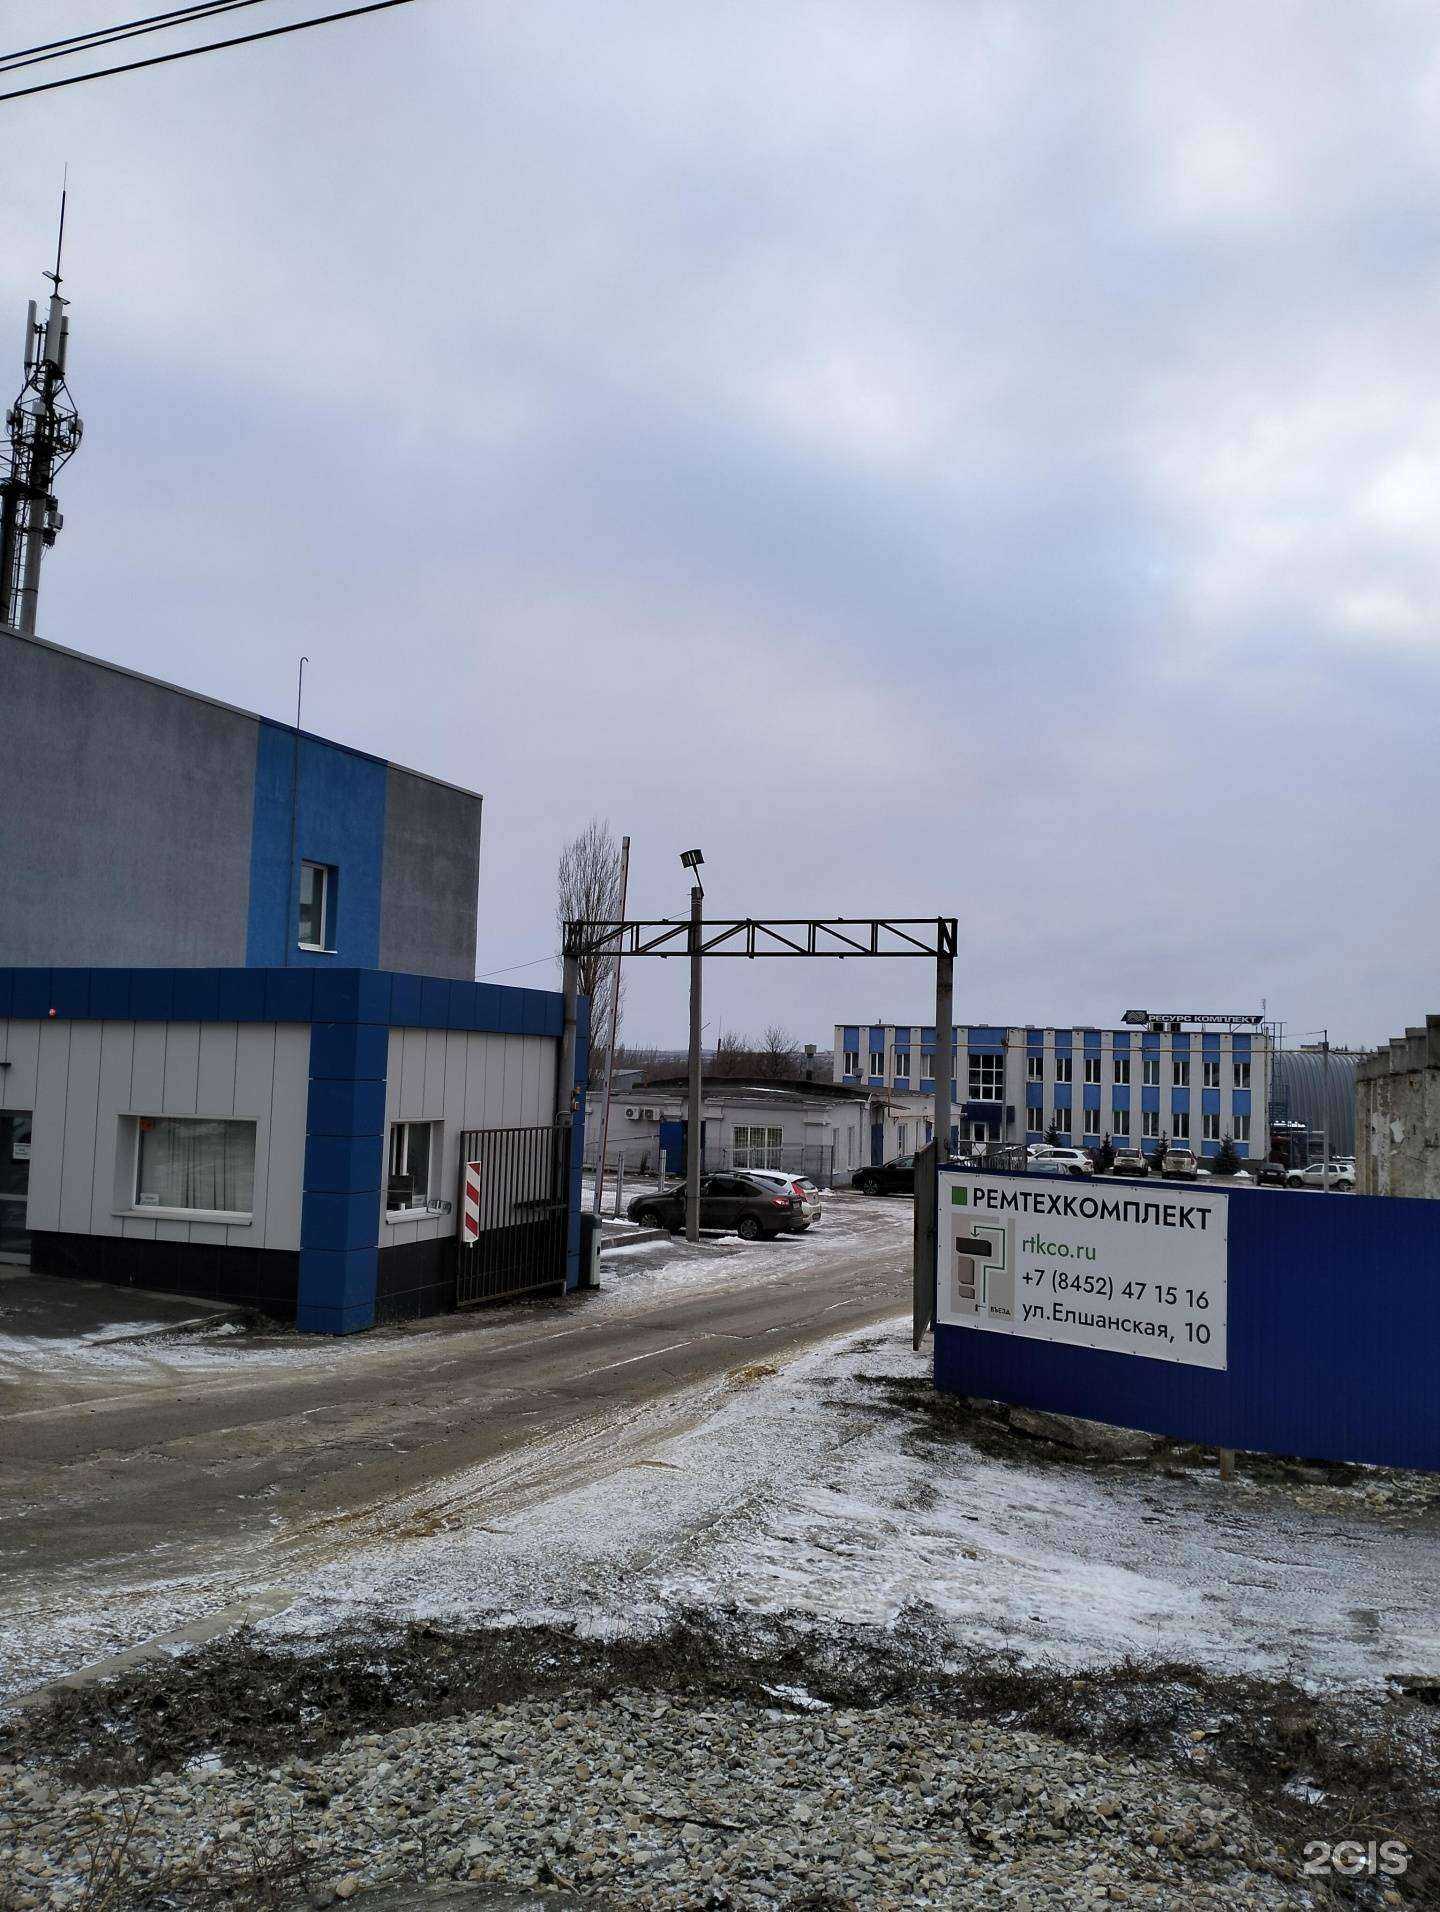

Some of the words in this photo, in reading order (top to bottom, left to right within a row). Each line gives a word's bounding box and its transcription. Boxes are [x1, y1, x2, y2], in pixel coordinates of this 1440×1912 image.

[1194, 1015, 1256, 1023] КОМПЛЕКТ
[972, 1187, 1212, 1230] РЕМТЕХКОМПЛЕКТ
[1022, 1233, 1096, 1261] rtkco.ru
[1022, 1269, 1046, 1288] +7
[1051, 1269, 1114, 1301] (8452)
[1121, 1281, 1146, 1301] 47
[1155, 1285, 1178, 1306] 15
[1186, 1289, 1210, 1310] 16
[1185, 1322, 1211, 1345] 10
